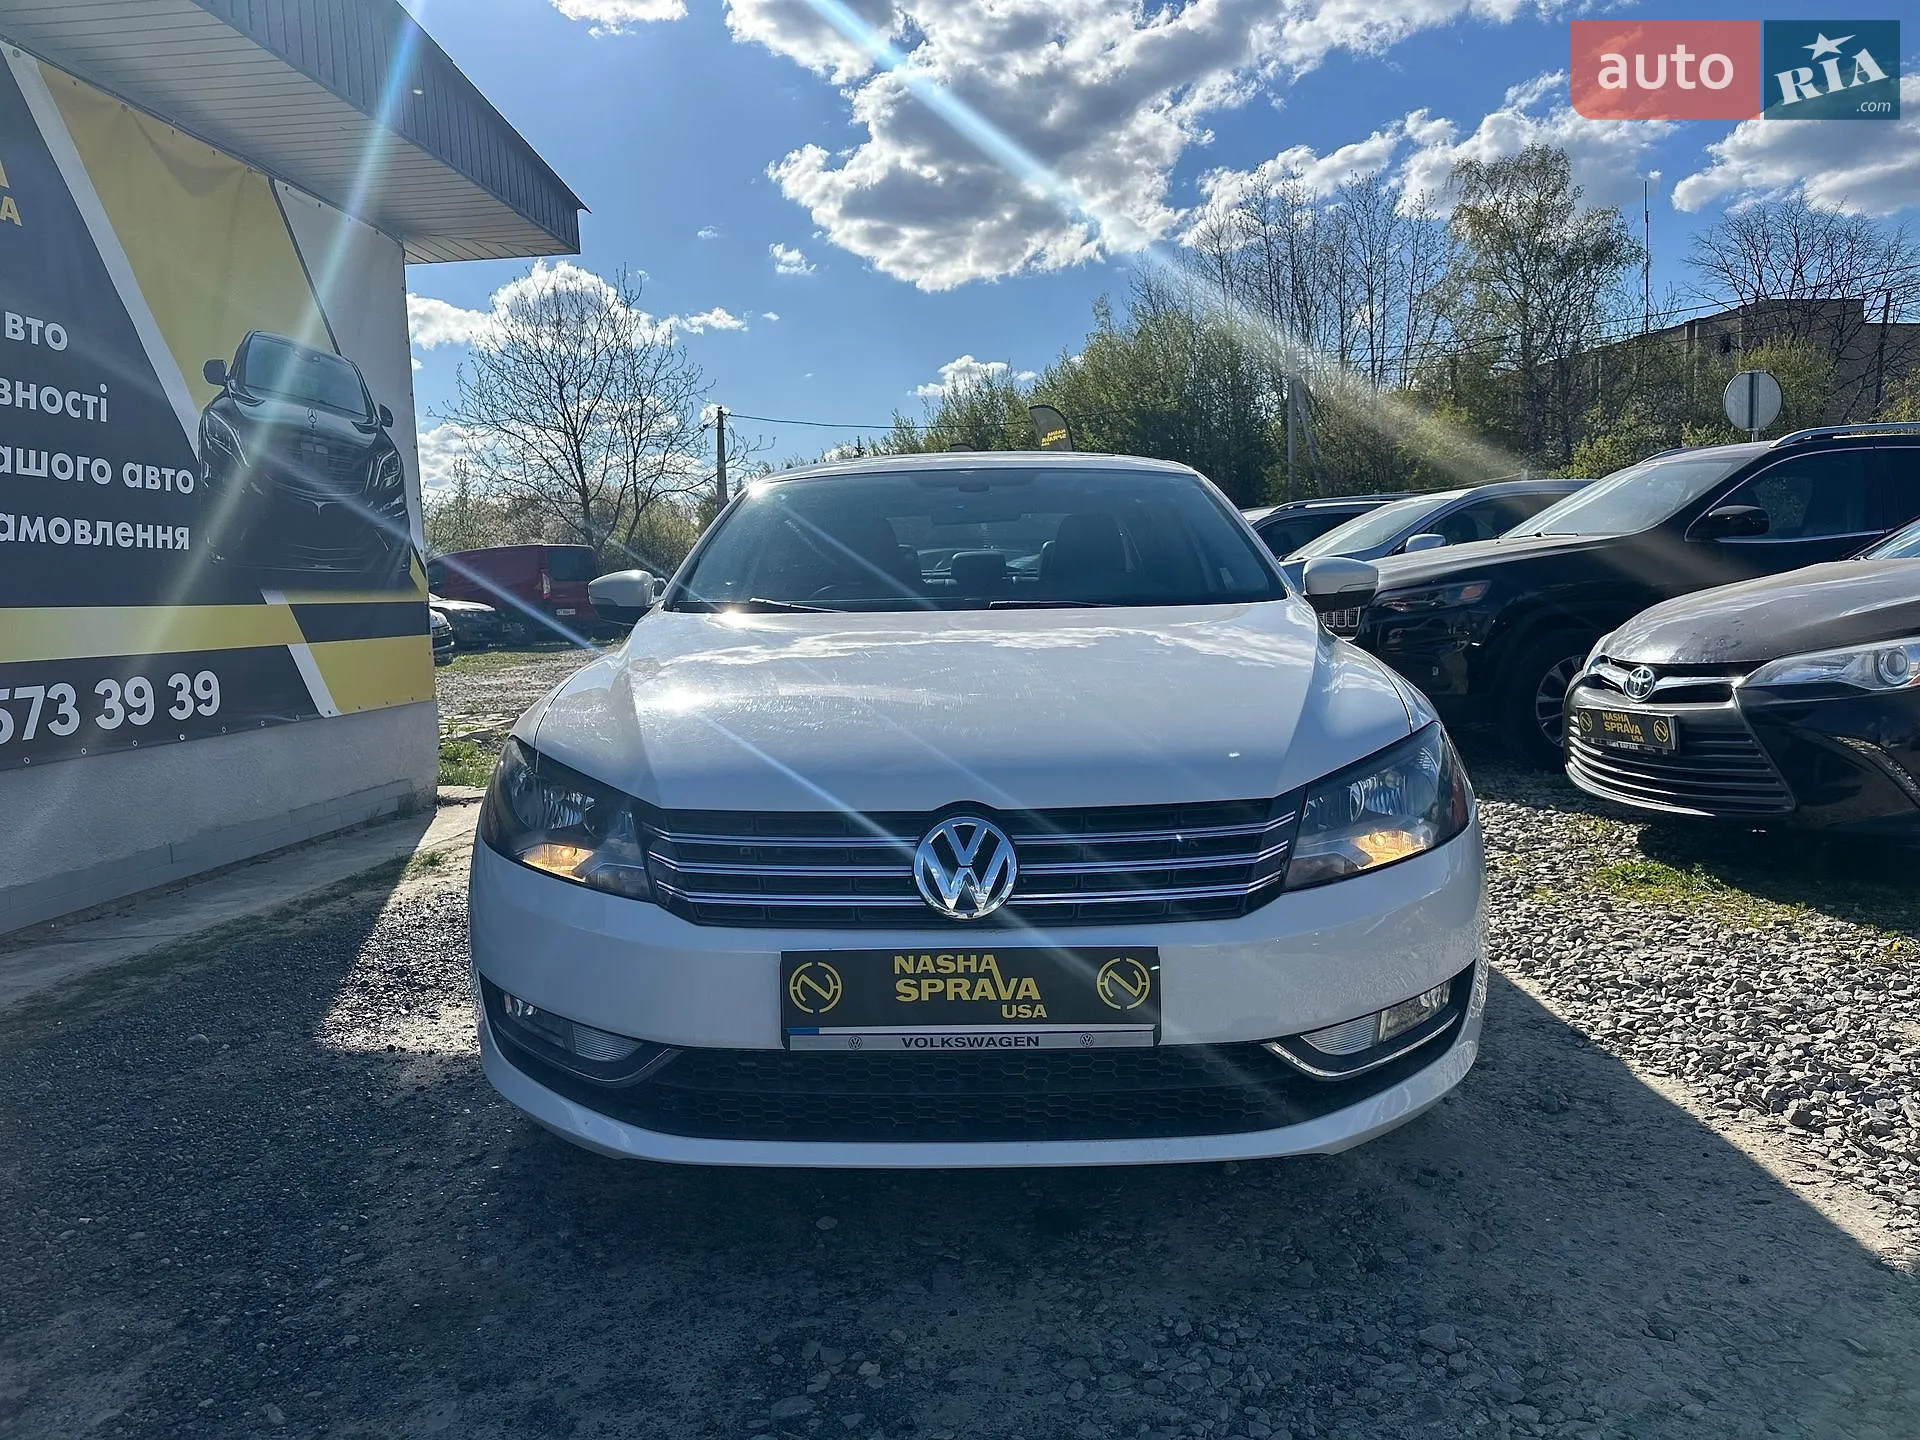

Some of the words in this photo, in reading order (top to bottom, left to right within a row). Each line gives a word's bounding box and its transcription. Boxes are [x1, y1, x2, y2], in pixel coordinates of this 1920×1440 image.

[122, 462, 195, 494] авто
[94, 676, 155, 730] 39
[167, 670, 221, 721] 39
[1602, 712, 1629, 723] NASHA
[1604, 721, 1641, 735] SPRAVA
[1631, 735, 1645, 743] USA
[894, 953, 998, 976] NASHA
[895, 976, 1042, 1003] SPRAVA
[1001, 1003, 1048, 1019] USA
[901, 1035, 1040, 1049] VOLKSWAGEN
